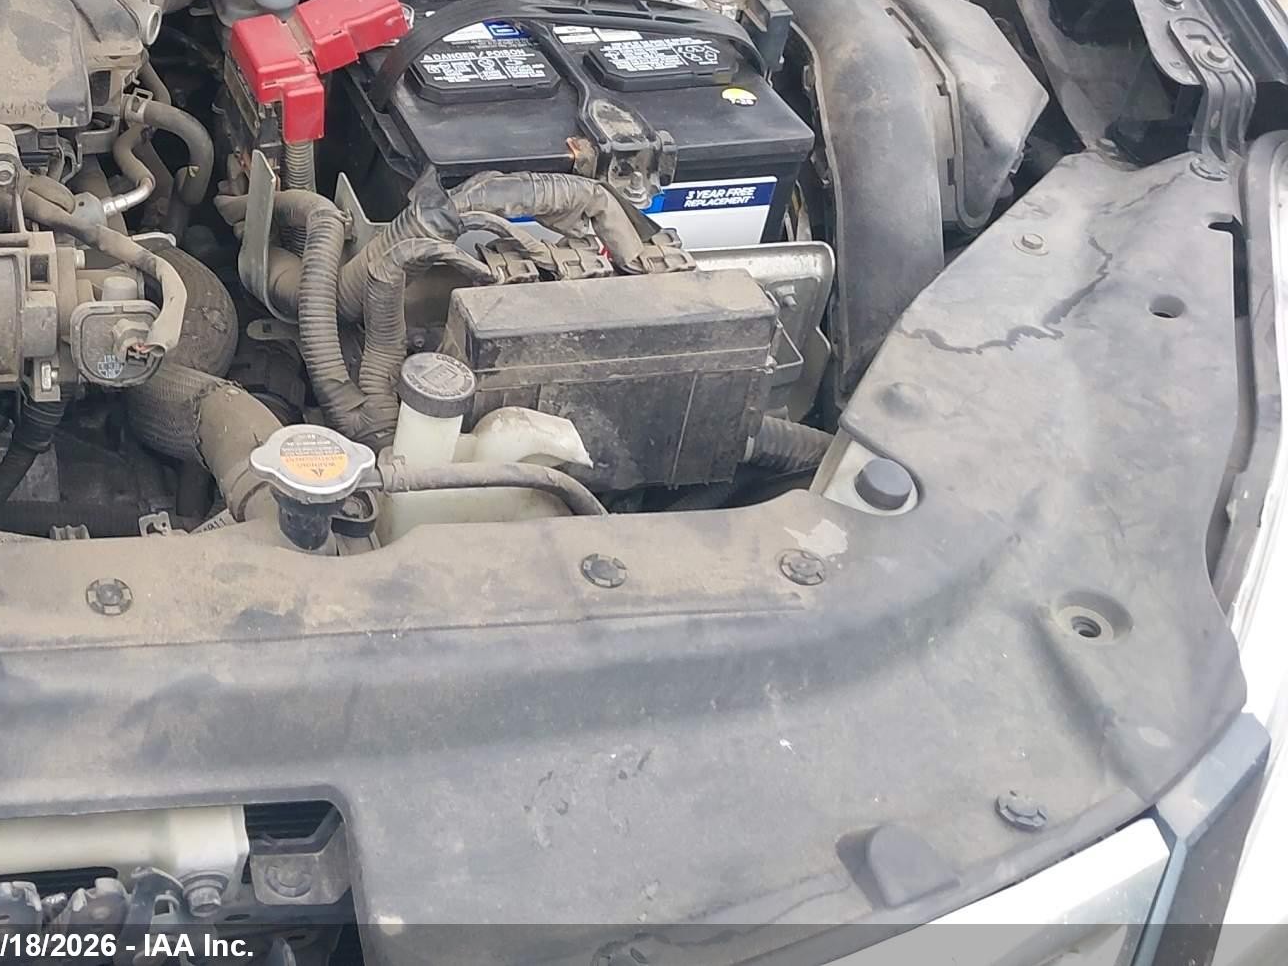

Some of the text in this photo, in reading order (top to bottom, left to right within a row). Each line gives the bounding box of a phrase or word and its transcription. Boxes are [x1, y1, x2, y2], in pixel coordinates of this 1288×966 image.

[686, 186, 757, 200] 3 YEAR FREE
